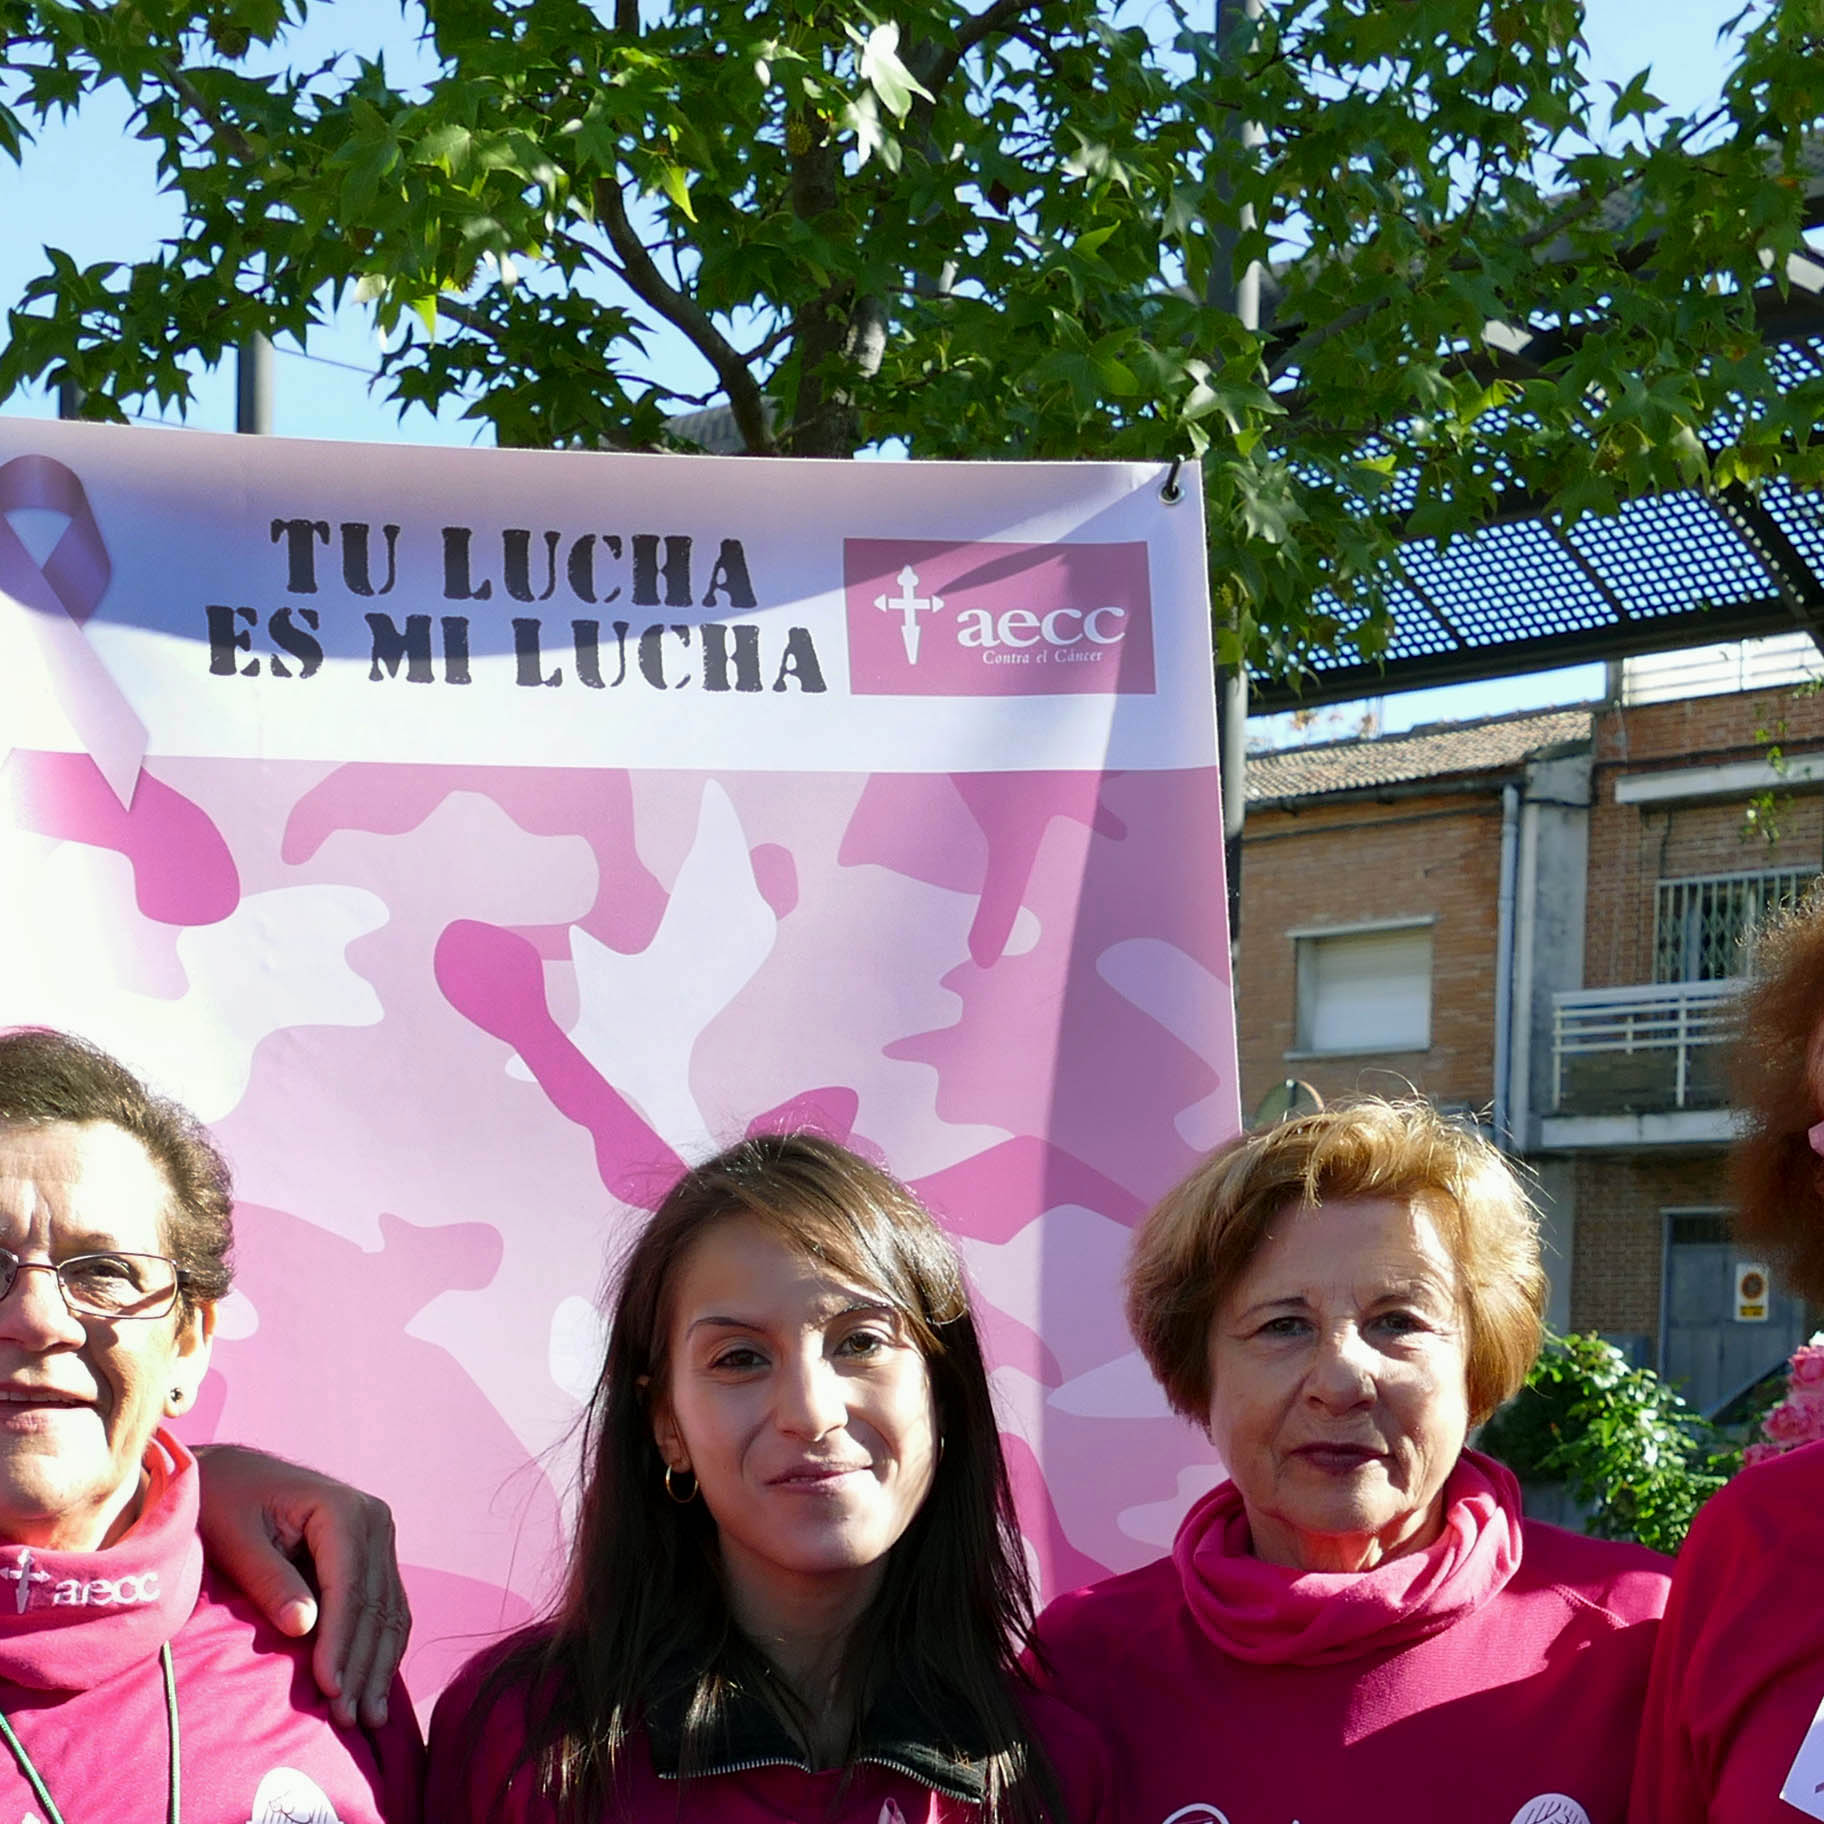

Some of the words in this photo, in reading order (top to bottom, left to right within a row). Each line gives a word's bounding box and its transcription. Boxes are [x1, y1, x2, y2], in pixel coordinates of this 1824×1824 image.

[270, 517, 398, 598] TU
[440, 527, 758, 609] LUCHA
[204, 606, 324, 678] ES
[368, 612, 471, 686] MI
[511, 618, 828, 694] LUCHA
[956, 606, 1126, 648] aecc
[982, 649, 1030, 665] Contra
[1036, 650, 1047, 664] el
[1054, 648, 1103, 664] Cáncer
